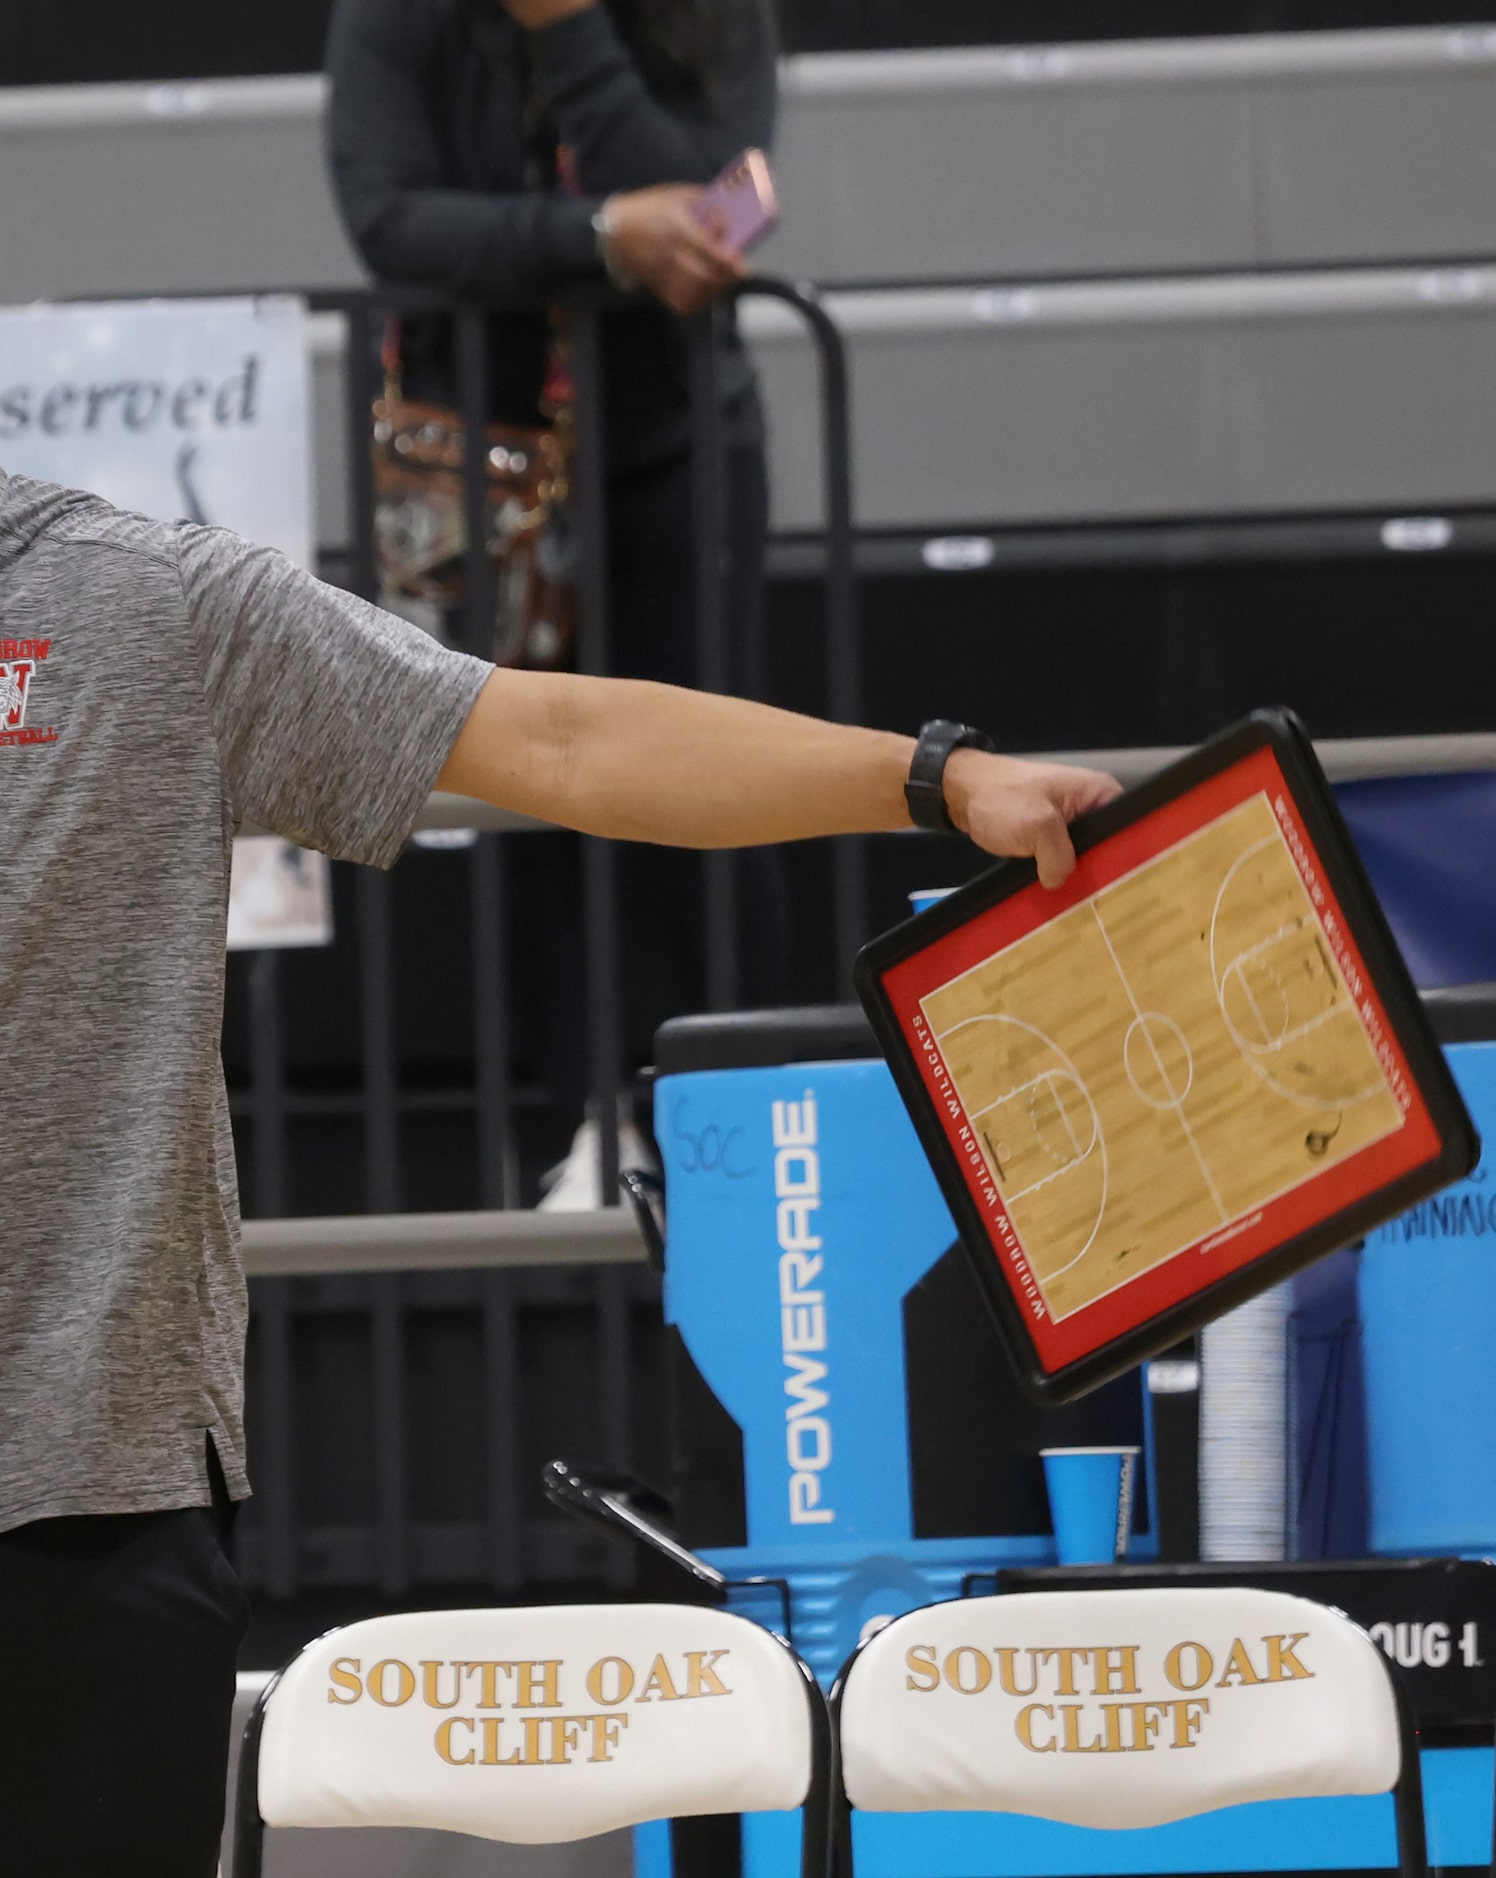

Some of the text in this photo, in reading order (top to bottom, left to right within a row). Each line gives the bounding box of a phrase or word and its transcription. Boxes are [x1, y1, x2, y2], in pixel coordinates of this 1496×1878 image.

[912, 1014, 1046, 1320] WOODROW WILSON WILDCATS
[771, 1097, 835, 1525] POWERADE
[327, 1649, 732, 1710] SOUTH OAK
[905, 1632, 1315, 1697] SOUTH OAK
[434, 1712, 628, 1766] CLIFF
[1014, 1697, 1210, 1753] CLIFF
